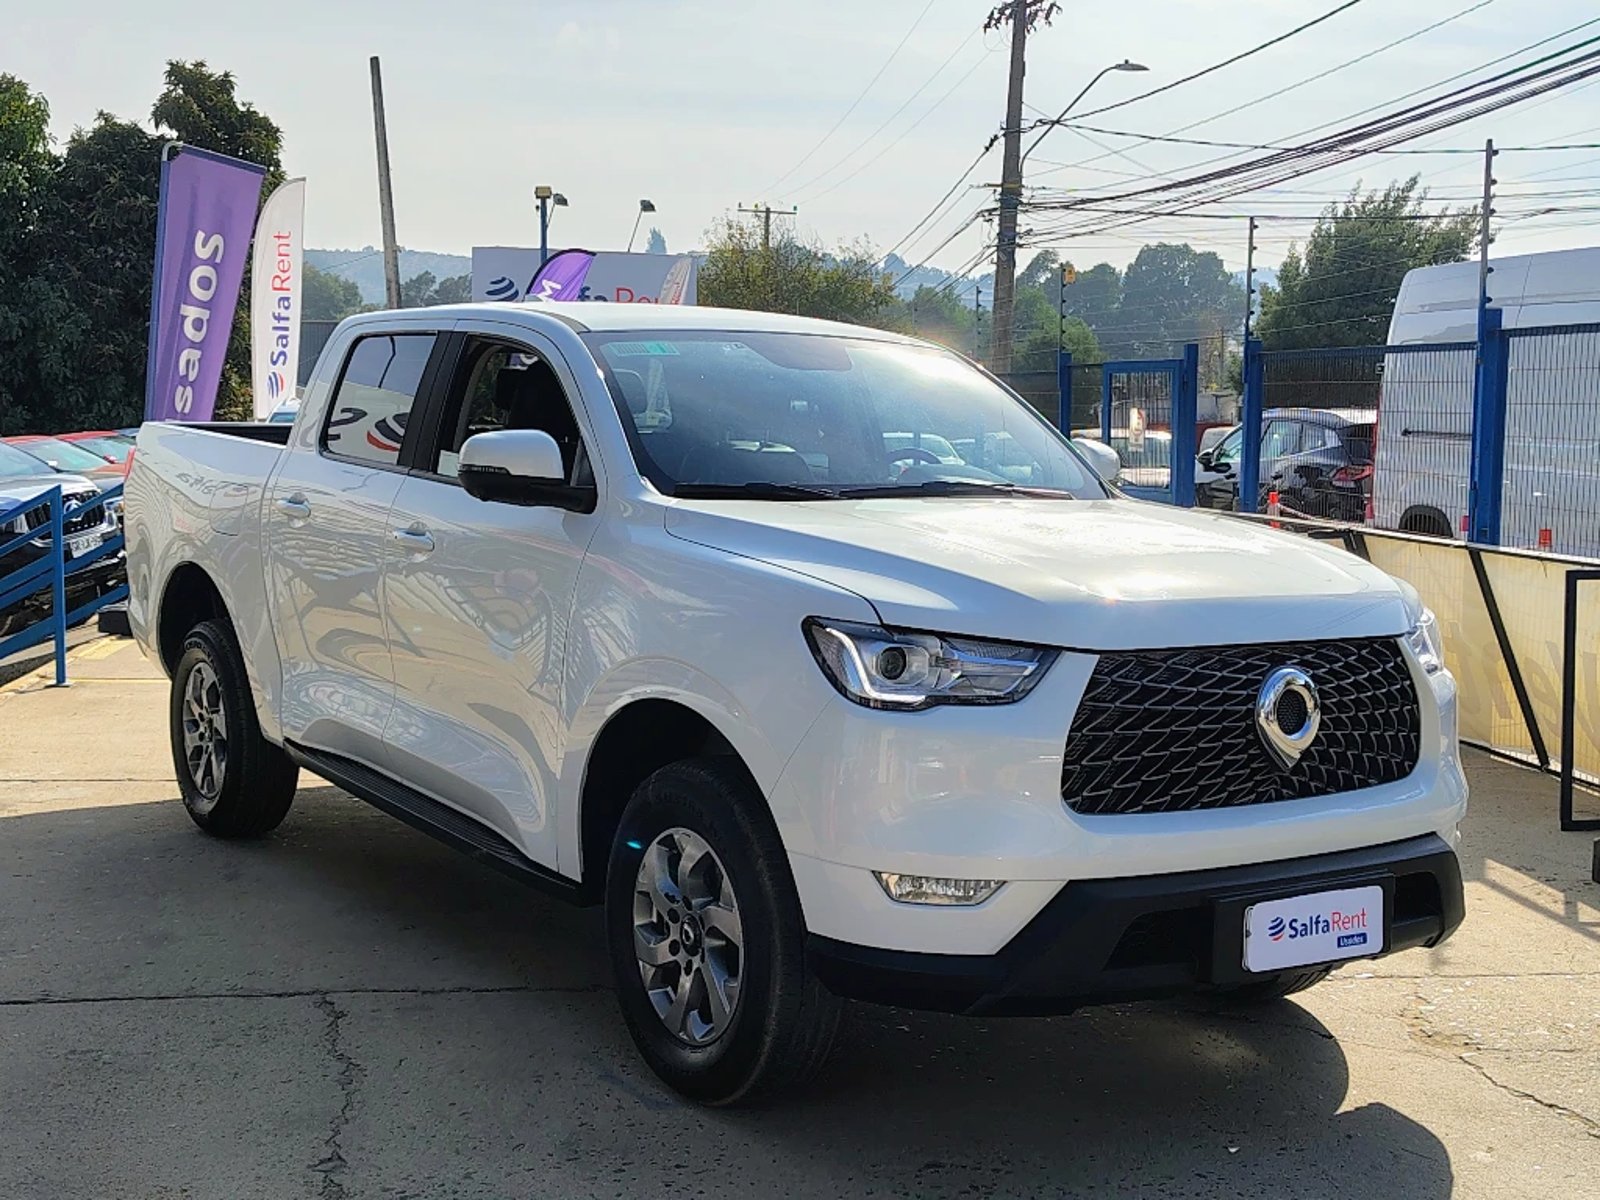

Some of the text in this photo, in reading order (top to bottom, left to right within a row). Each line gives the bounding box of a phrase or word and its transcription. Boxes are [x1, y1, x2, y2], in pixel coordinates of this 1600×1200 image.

[165, 229, 225, 421] sados
[268, 230, 292, 367] SalfaRent
[1288, 907, 1368, 940] SalfaRent
